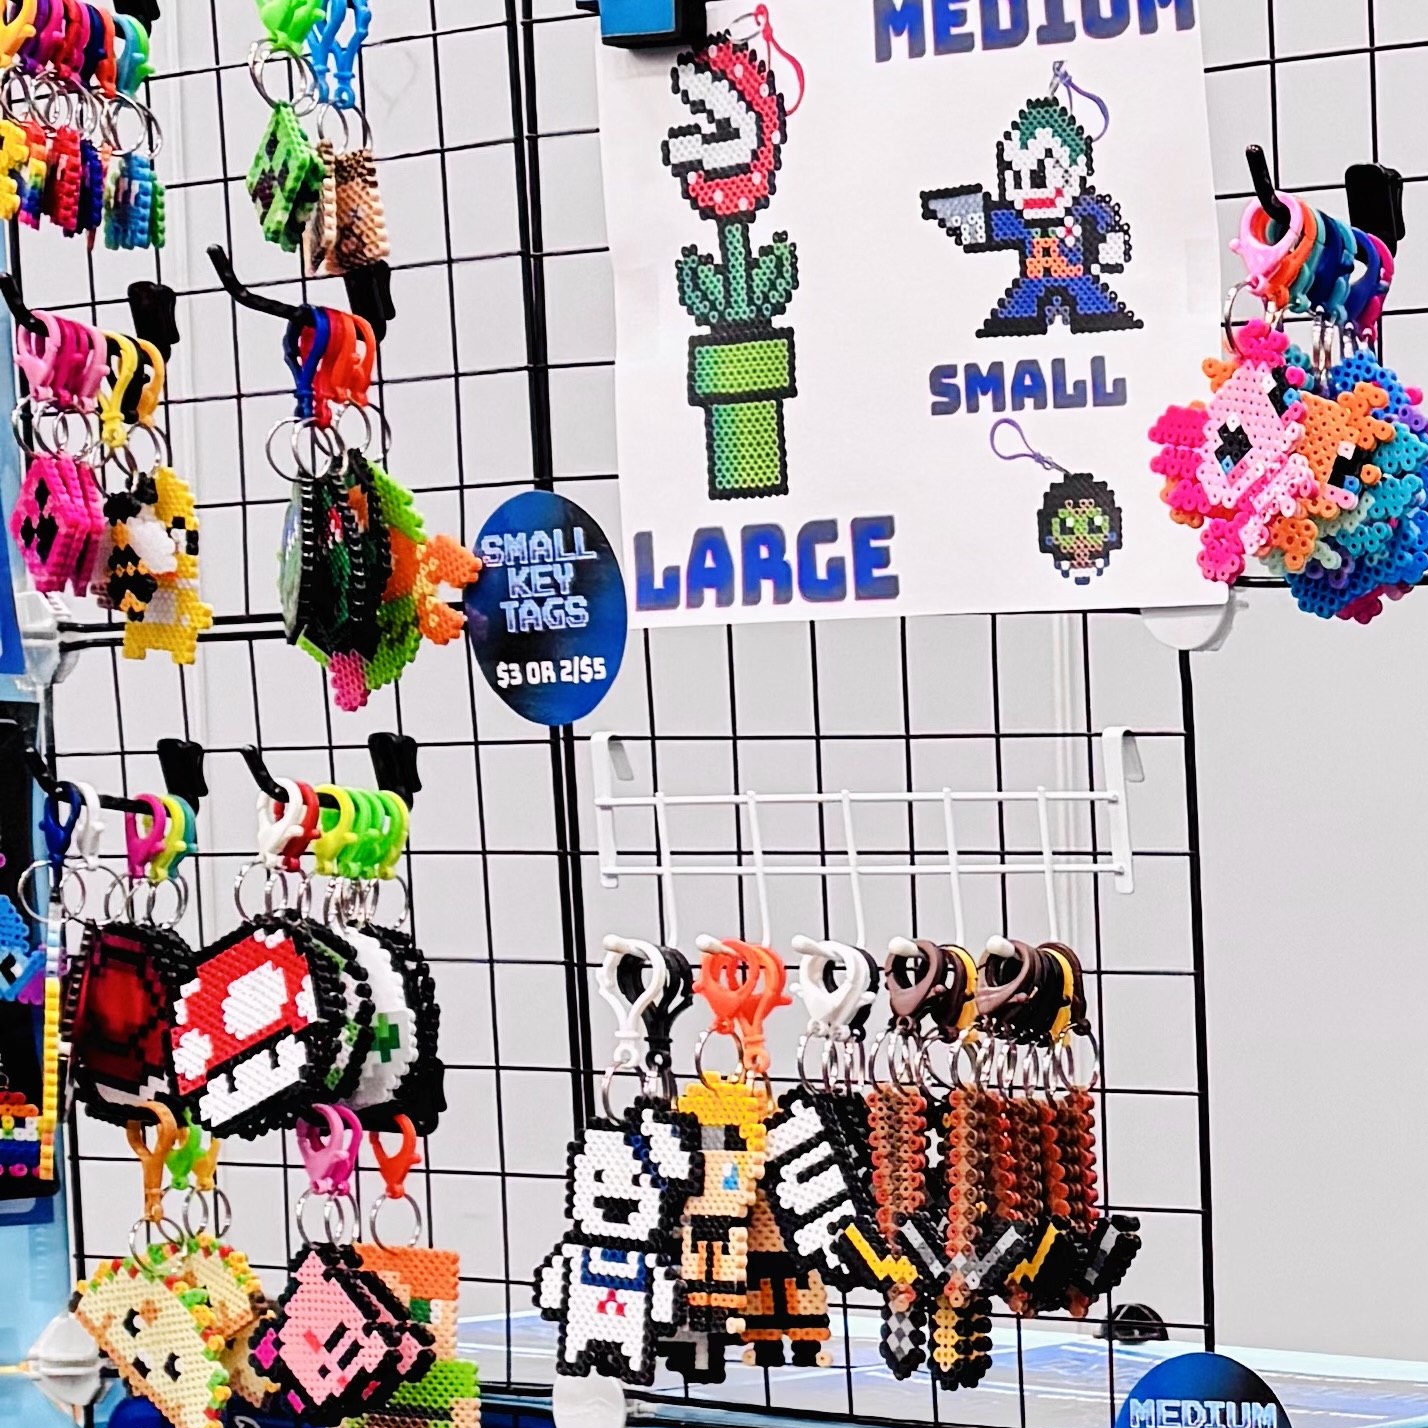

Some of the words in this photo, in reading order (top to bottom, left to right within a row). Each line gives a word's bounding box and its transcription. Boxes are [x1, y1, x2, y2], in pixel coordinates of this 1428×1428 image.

[929, 355, 1128, 416] SMALL
[481, 527, 598, 567] SMALL
[633, 515, 900, 613] LARGE
[507, 563, 575, 600] KEY
[501, 596, 590, 634] TAGS
[496, 660, 522, 689] $3
[526, 660, 557, 685] OR
[560, 655, 607, 686] 2/$5
